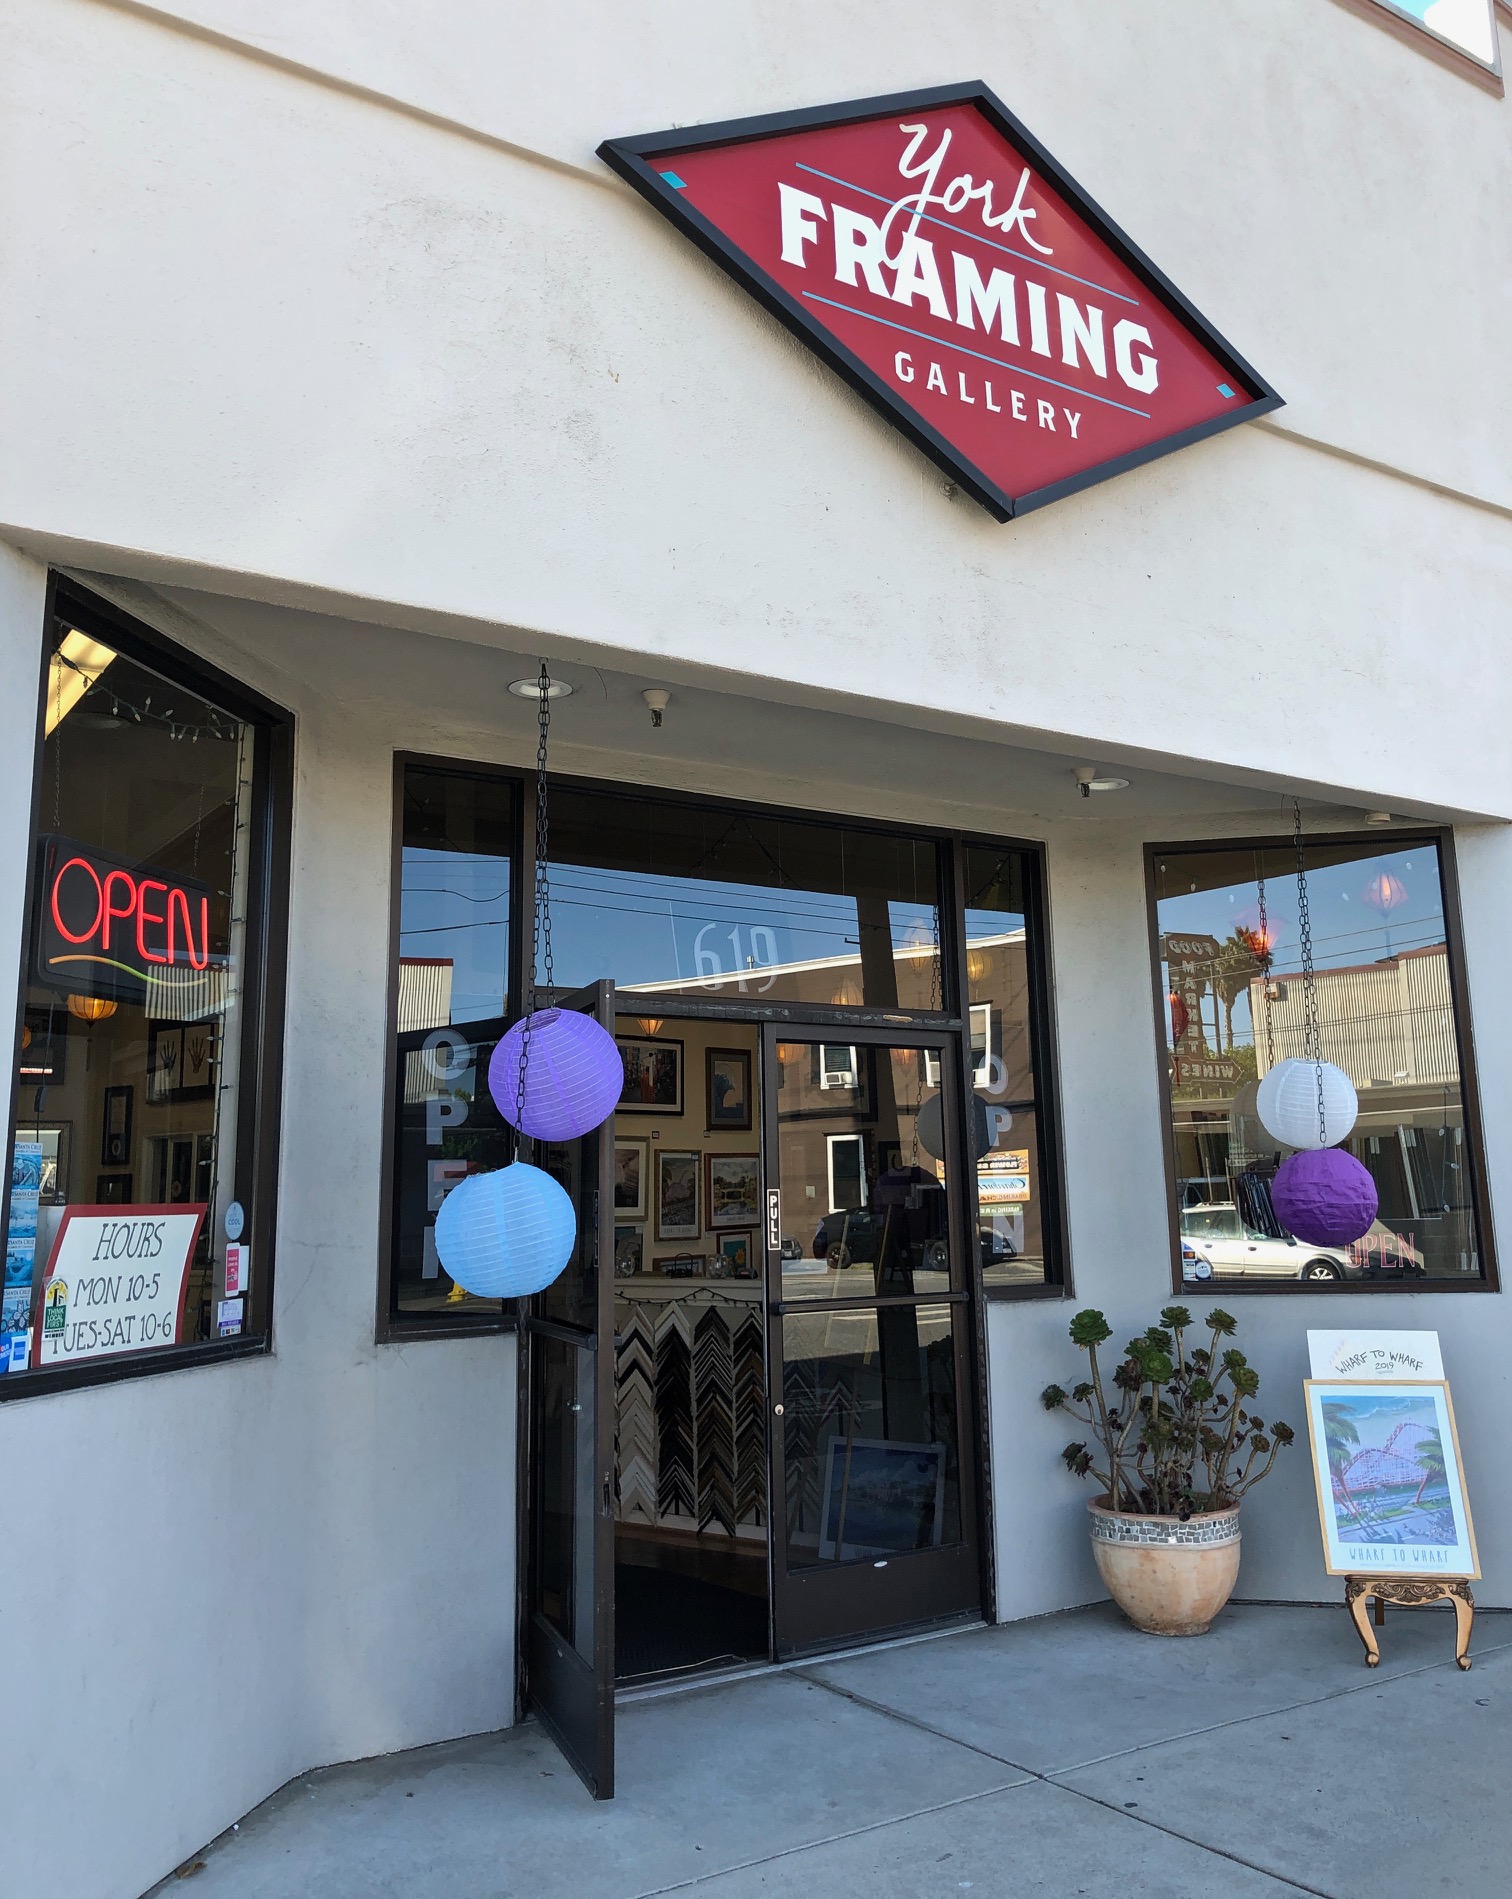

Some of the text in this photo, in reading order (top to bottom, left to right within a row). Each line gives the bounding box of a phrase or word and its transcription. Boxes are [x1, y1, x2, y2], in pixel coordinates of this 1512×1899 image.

[881, 122, 1054, 269] York
[777, 181, 1159, 395] FRAMING
[894, 350, 1082, 440] GALLERY
[51, 857, 208, 971] OPEN
[693, 922, 779, 993] 619
[978, 1053, 1025, 1254] OPN
[769, 1195, 778, 1244] PULL
[92, 1221, 166, 1261] HOURS
[1345, 1232, 1416, 1269] OPEN
[73, 1272, 161, 1307] MON 10-5
[46, 1320, 63, 1328] FIRST
[47, 1307, 64, 1315] THINK
[47, 1313, 63, 1322] LOCAL
[140, 1311, 172, 1342] 10-6
[1335, 1349, 1423, 1374] WHARF TO WHARF
[1375, 1361, 1394, 1370] 2019
[1349, 1548, 1448, 1563] WHARF TO WHARF
